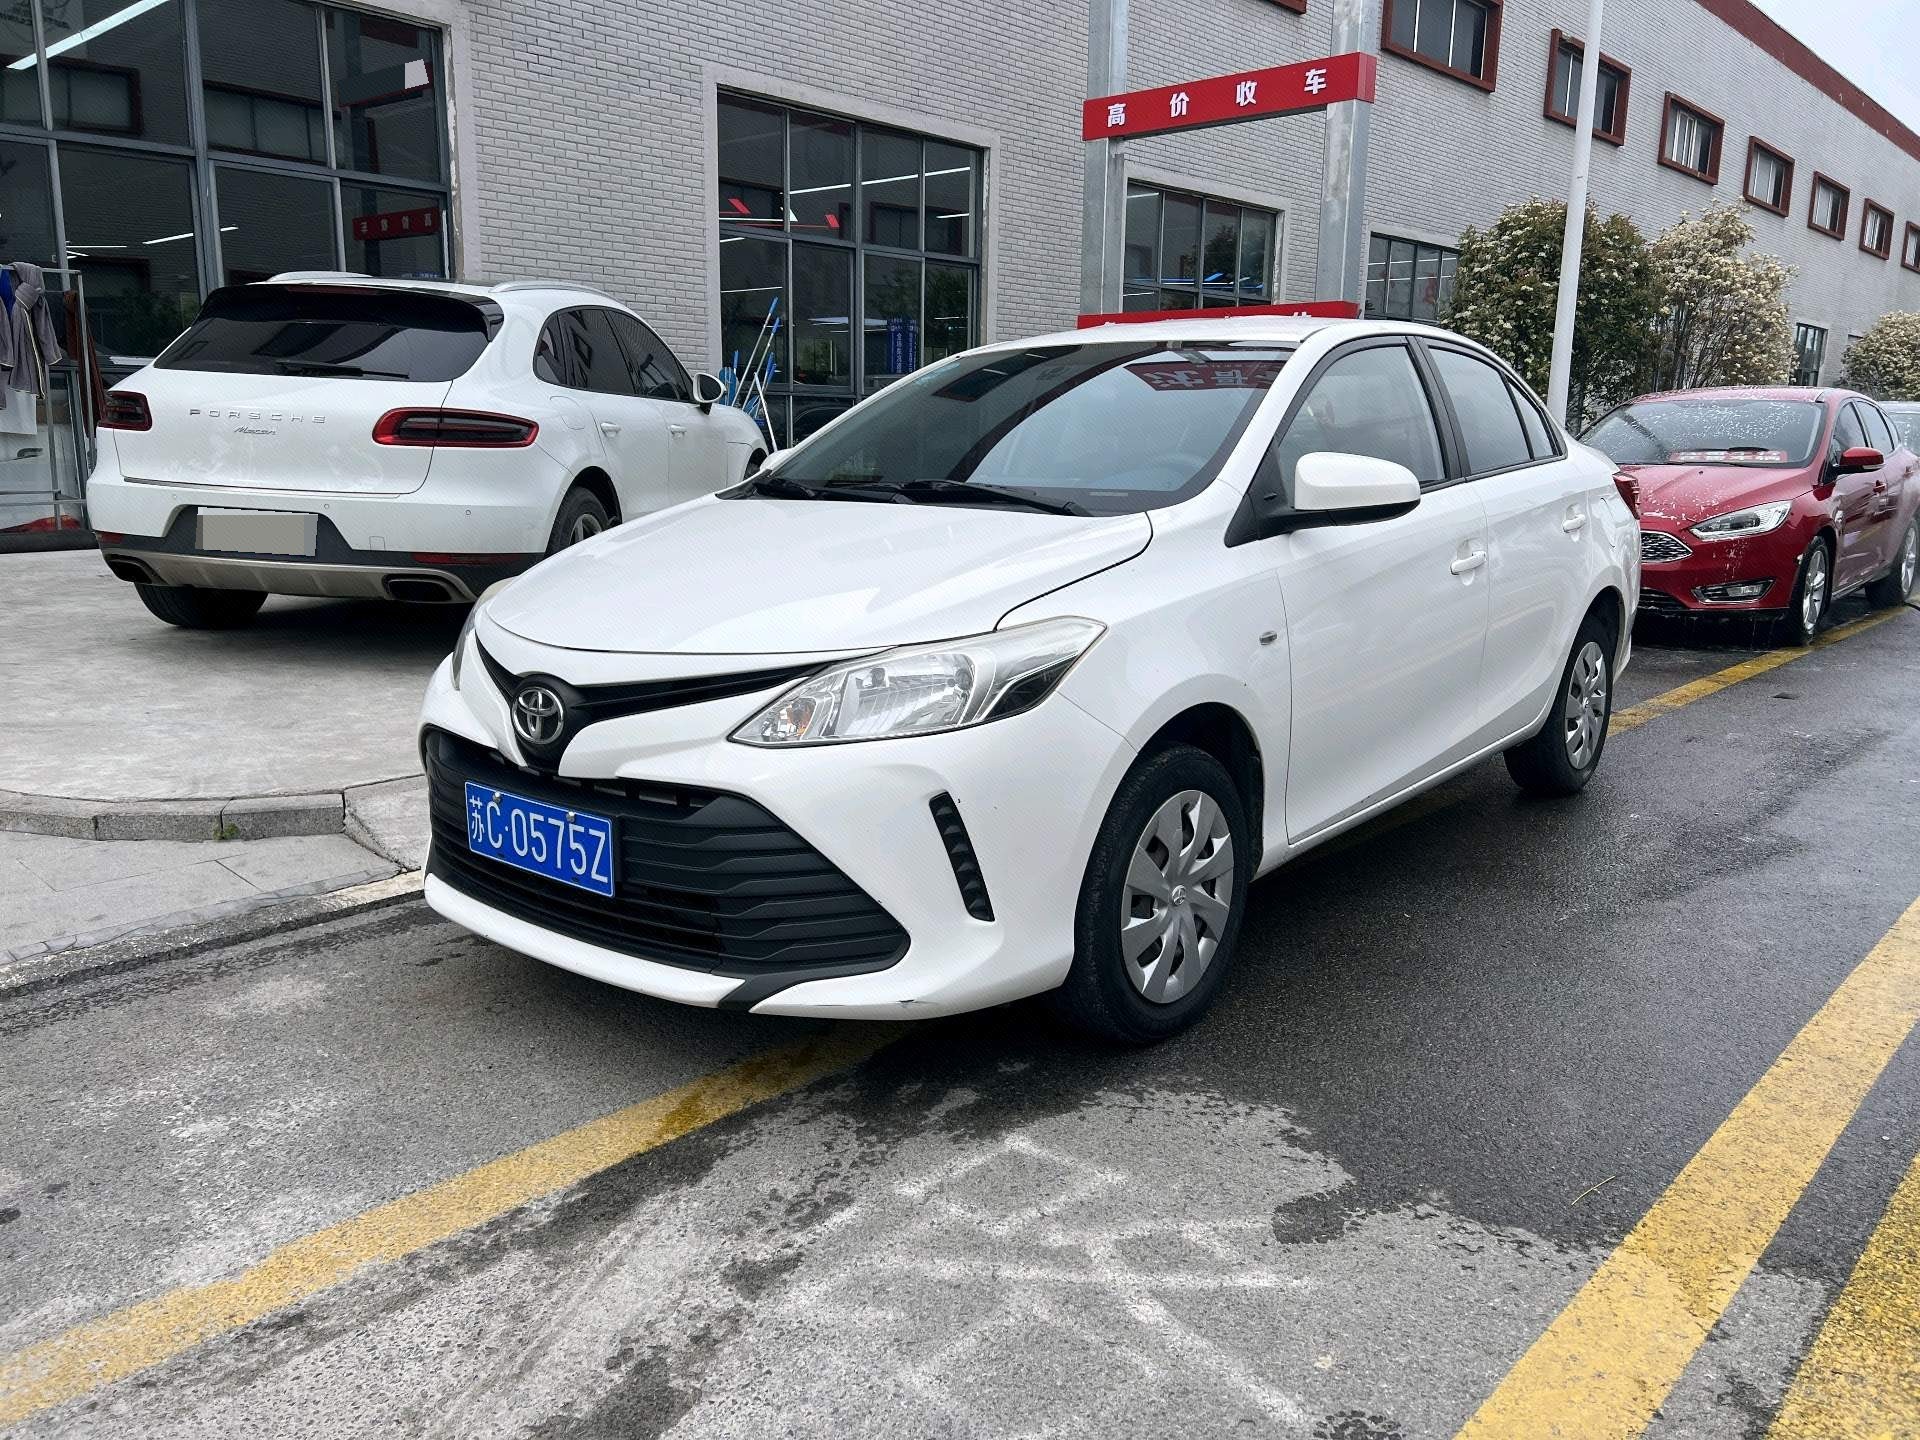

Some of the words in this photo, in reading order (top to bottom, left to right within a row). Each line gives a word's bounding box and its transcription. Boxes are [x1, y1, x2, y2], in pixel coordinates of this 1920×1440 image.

[1107, 68, 1327, 128] 高价收车
[189, 408, 326, 424] PORSCHE
[234, 425, 276, 436] Macan
